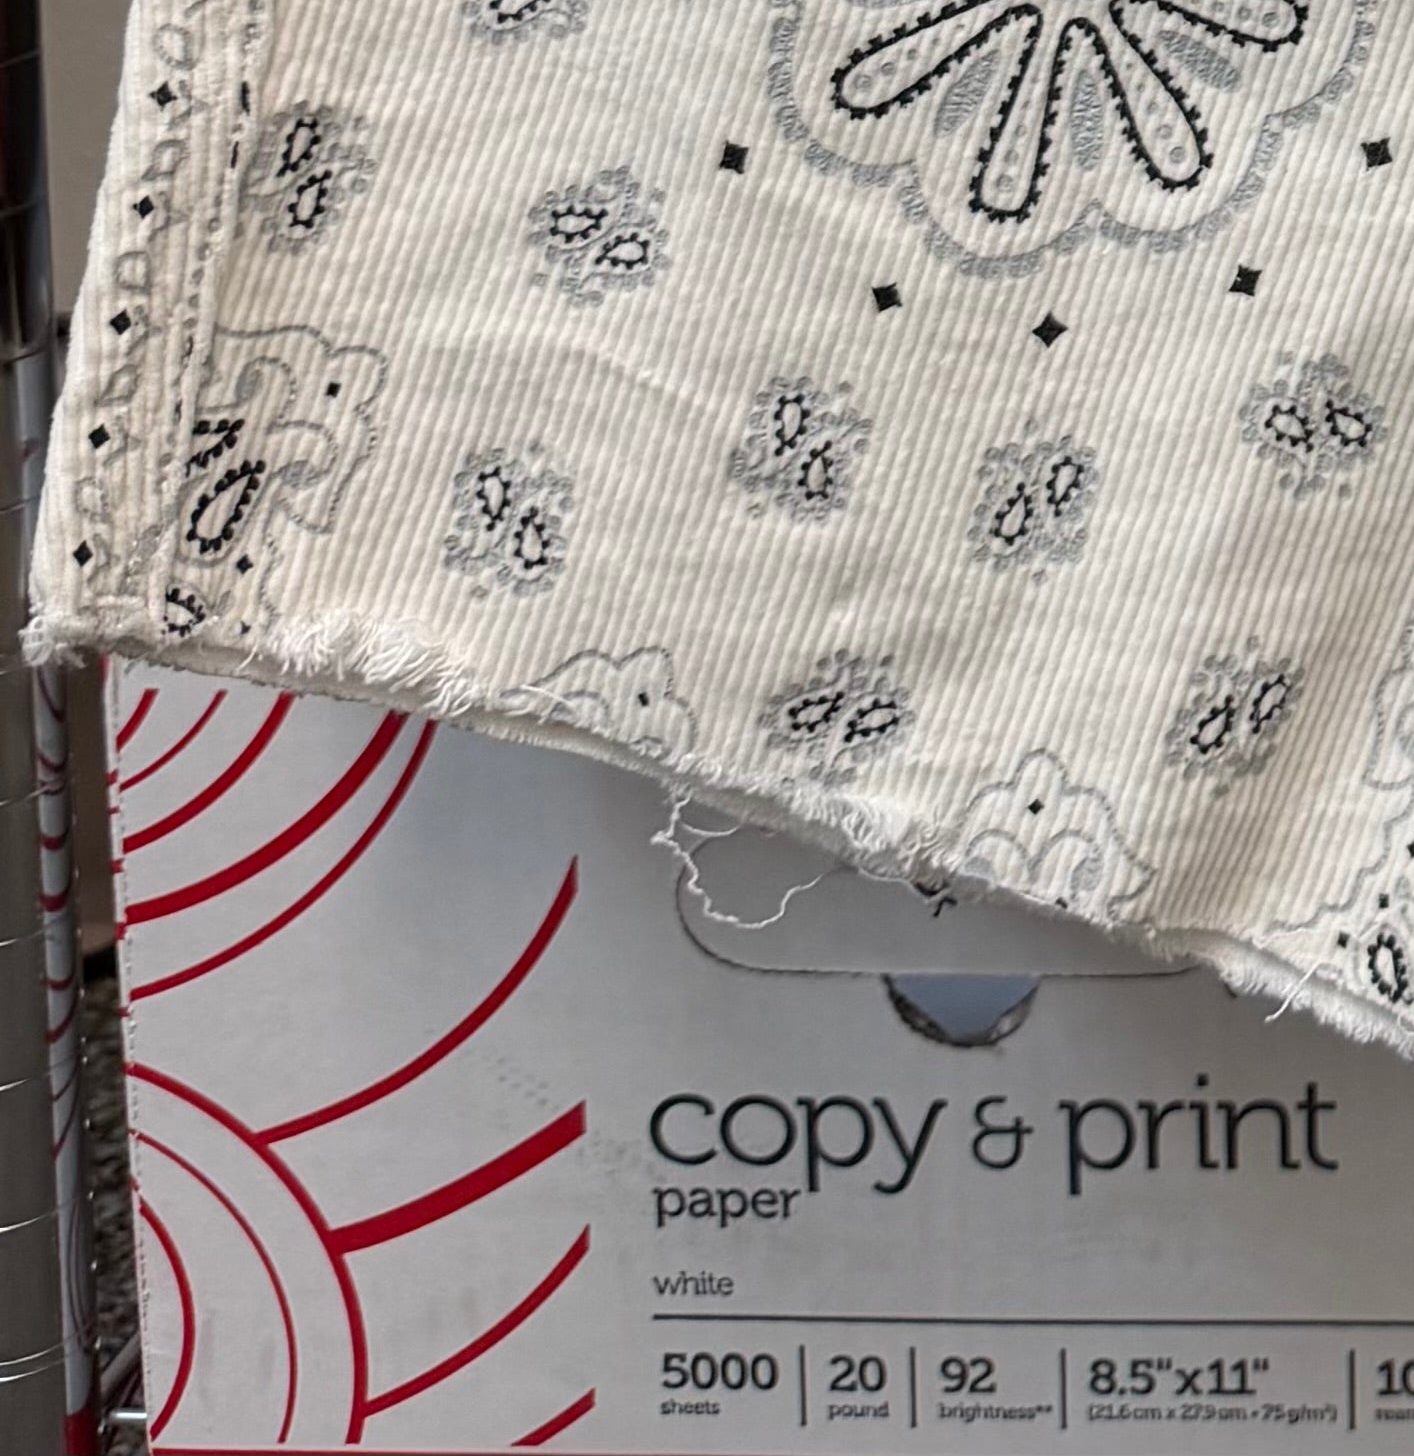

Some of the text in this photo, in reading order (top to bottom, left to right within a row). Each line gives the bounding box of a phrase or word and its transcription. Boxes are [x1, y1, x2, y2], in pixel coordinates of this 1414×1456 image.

[649, 1072, 1340, 1197] copy & print
[653, 1184, 801, 1228] paper
[652, 1271, 735, 1296] white
[661, 1352, 780, 1390] 5000
[829, 1355, 888, 1393] 20
[940, 1356, 998, 1394] 92
[660, 1400, 722, 1417] sheets
[827, 1401, 890, 1421] pound
